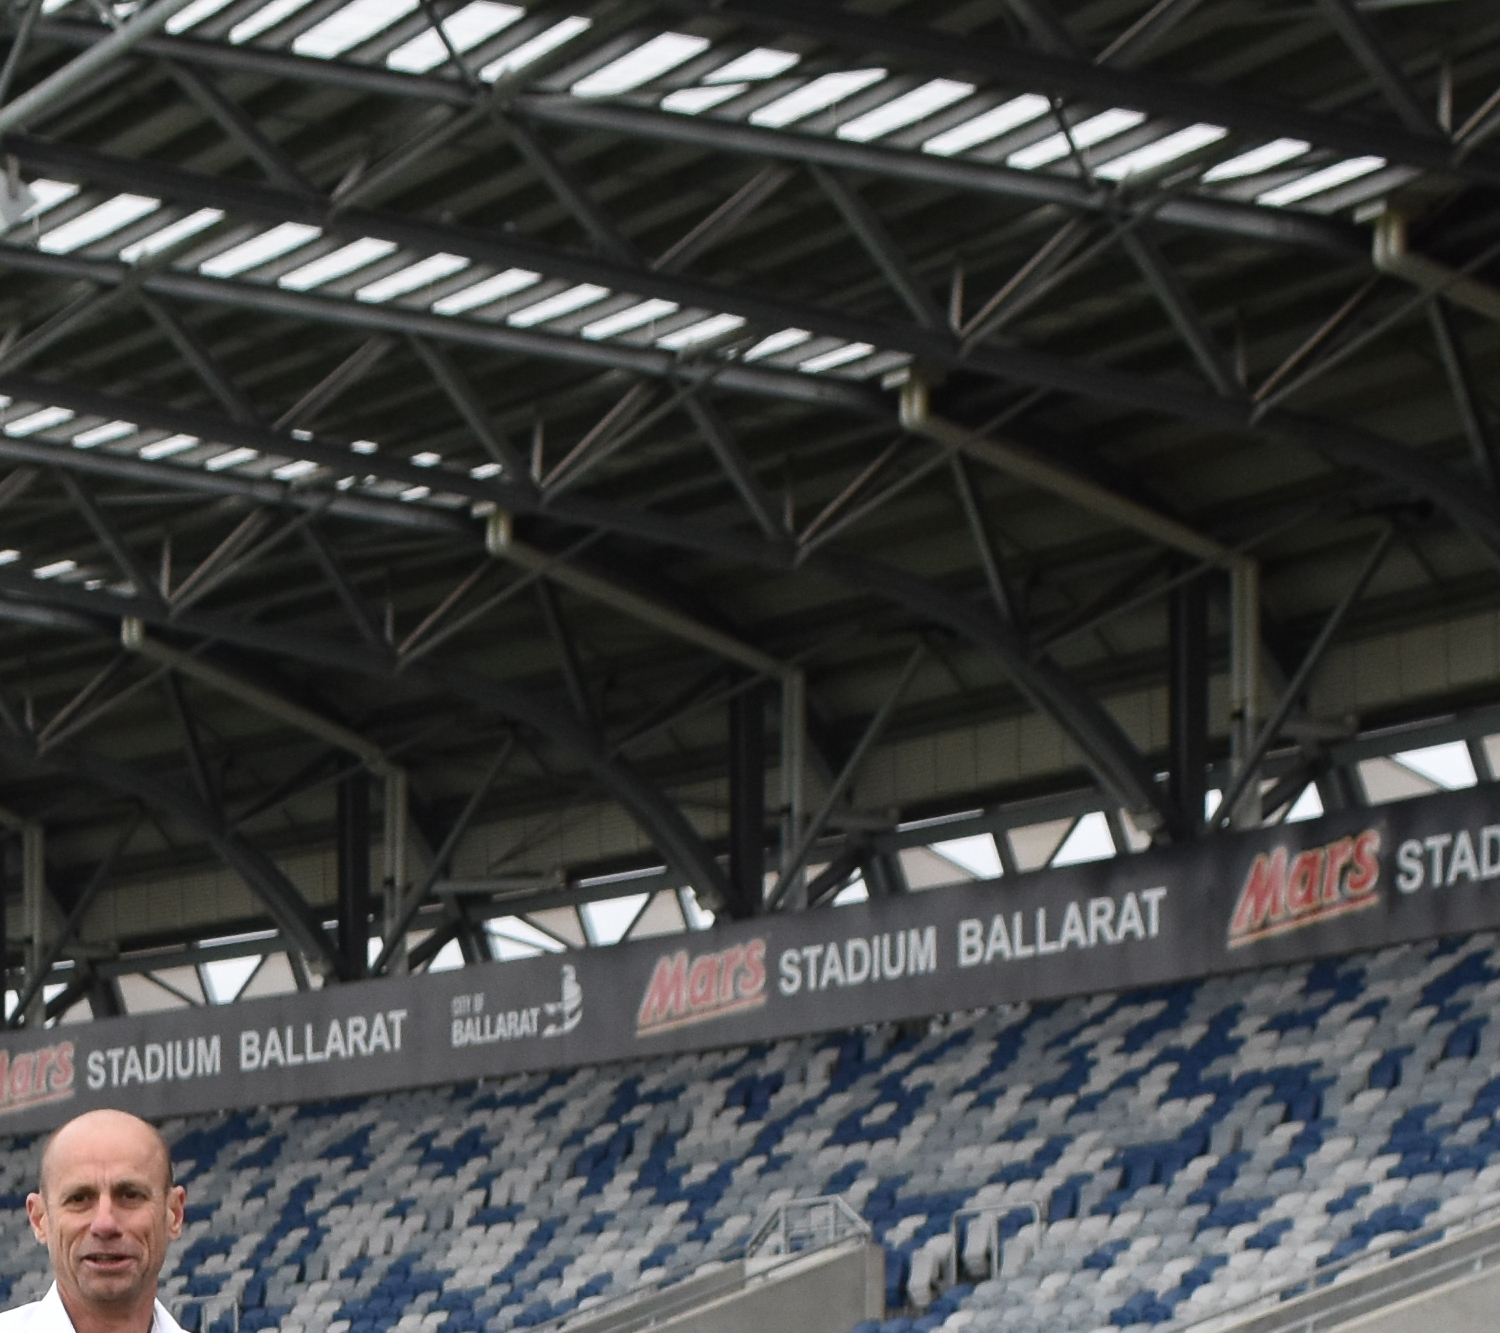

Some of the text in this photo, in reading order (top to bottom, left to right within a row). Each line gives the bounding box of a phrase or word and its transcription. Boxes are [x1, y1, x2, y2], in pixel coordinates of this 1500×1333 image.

[1229, 828, 1380, 935] Mars
[637, 886, 1167, 1026] Mars STADIUM BALLARAT
[87, 1035, 222, 1090] STADIUM
[239, 1009, 408, 1072] BALLARAT
[452, 1007, 540, 1047] BALLARAT
